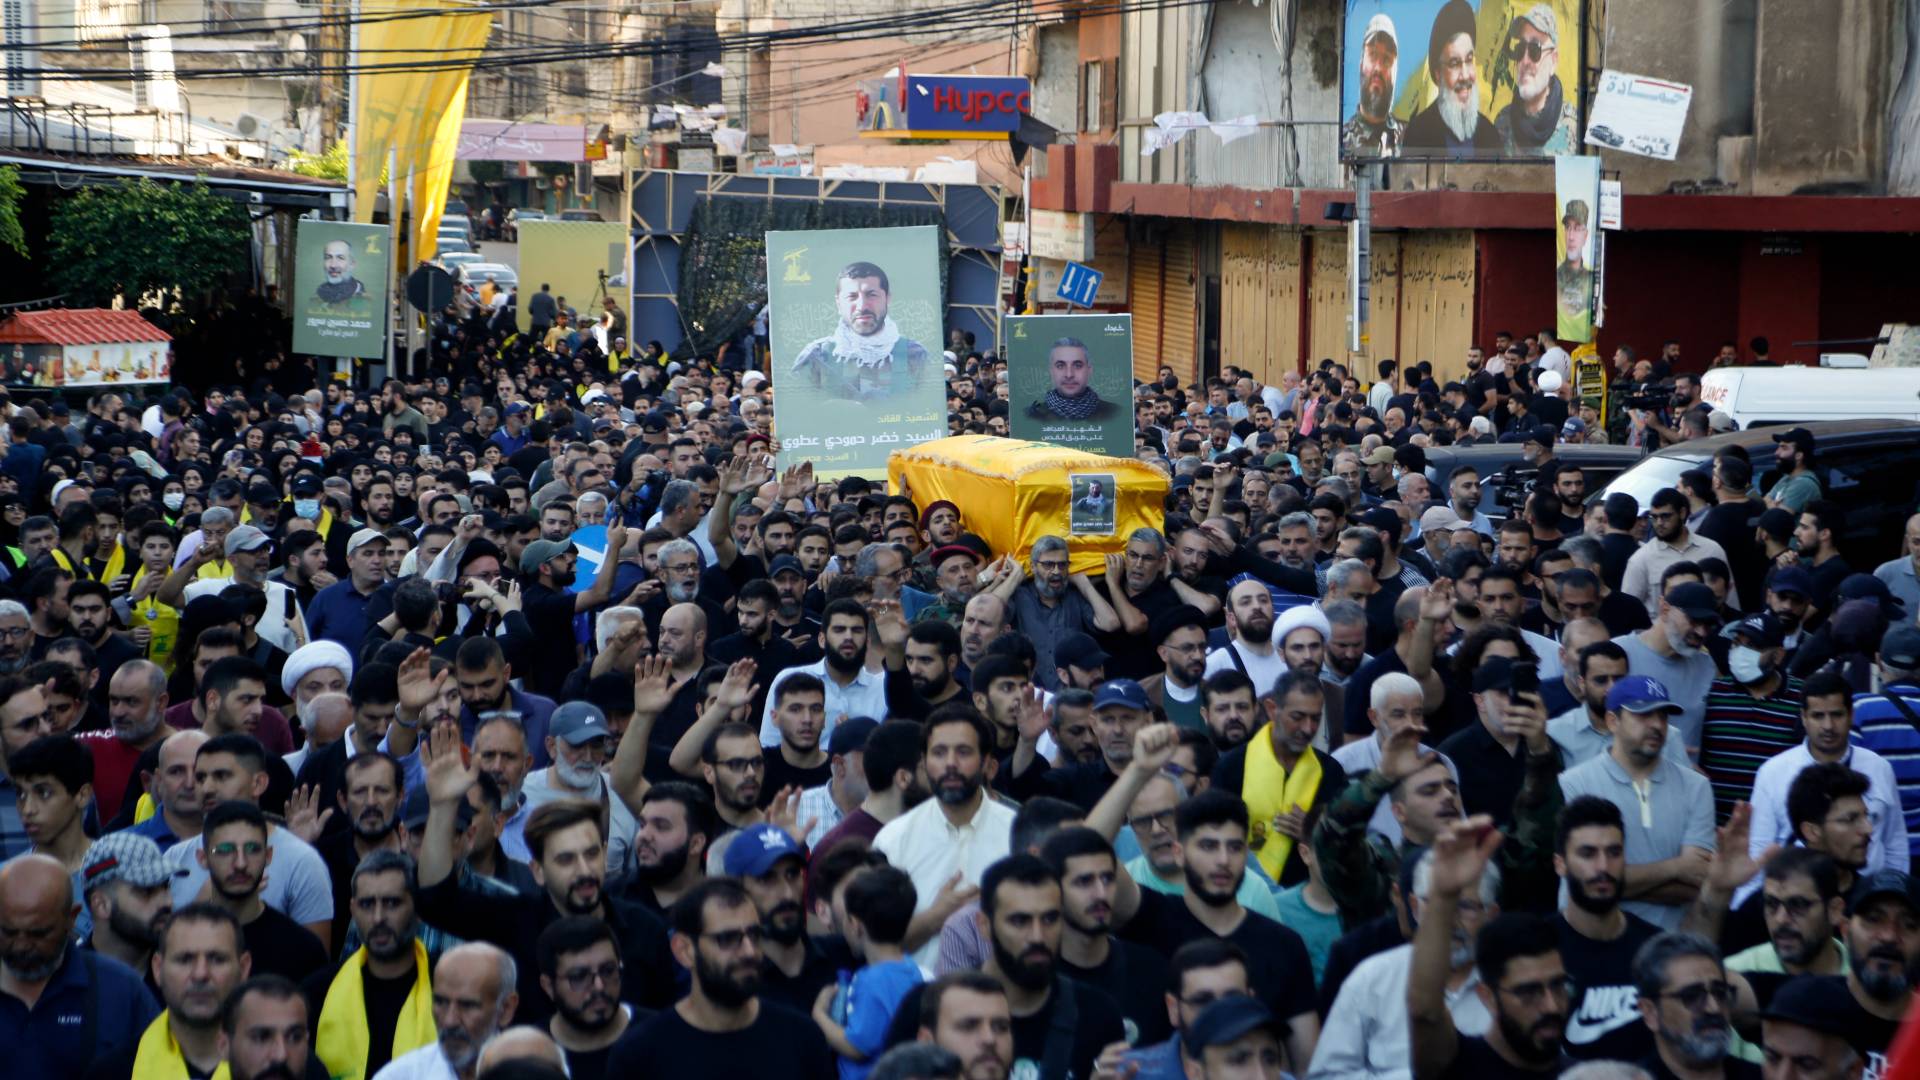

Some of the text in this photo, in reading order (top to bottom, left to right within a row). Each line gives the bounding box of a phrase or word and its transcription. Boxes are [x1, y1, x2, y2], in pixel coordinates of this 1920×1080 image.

[782, 428, 942, 452] السيد خضر حمودي عطوي
[1580, 985, 1639, 1020] NIKE
